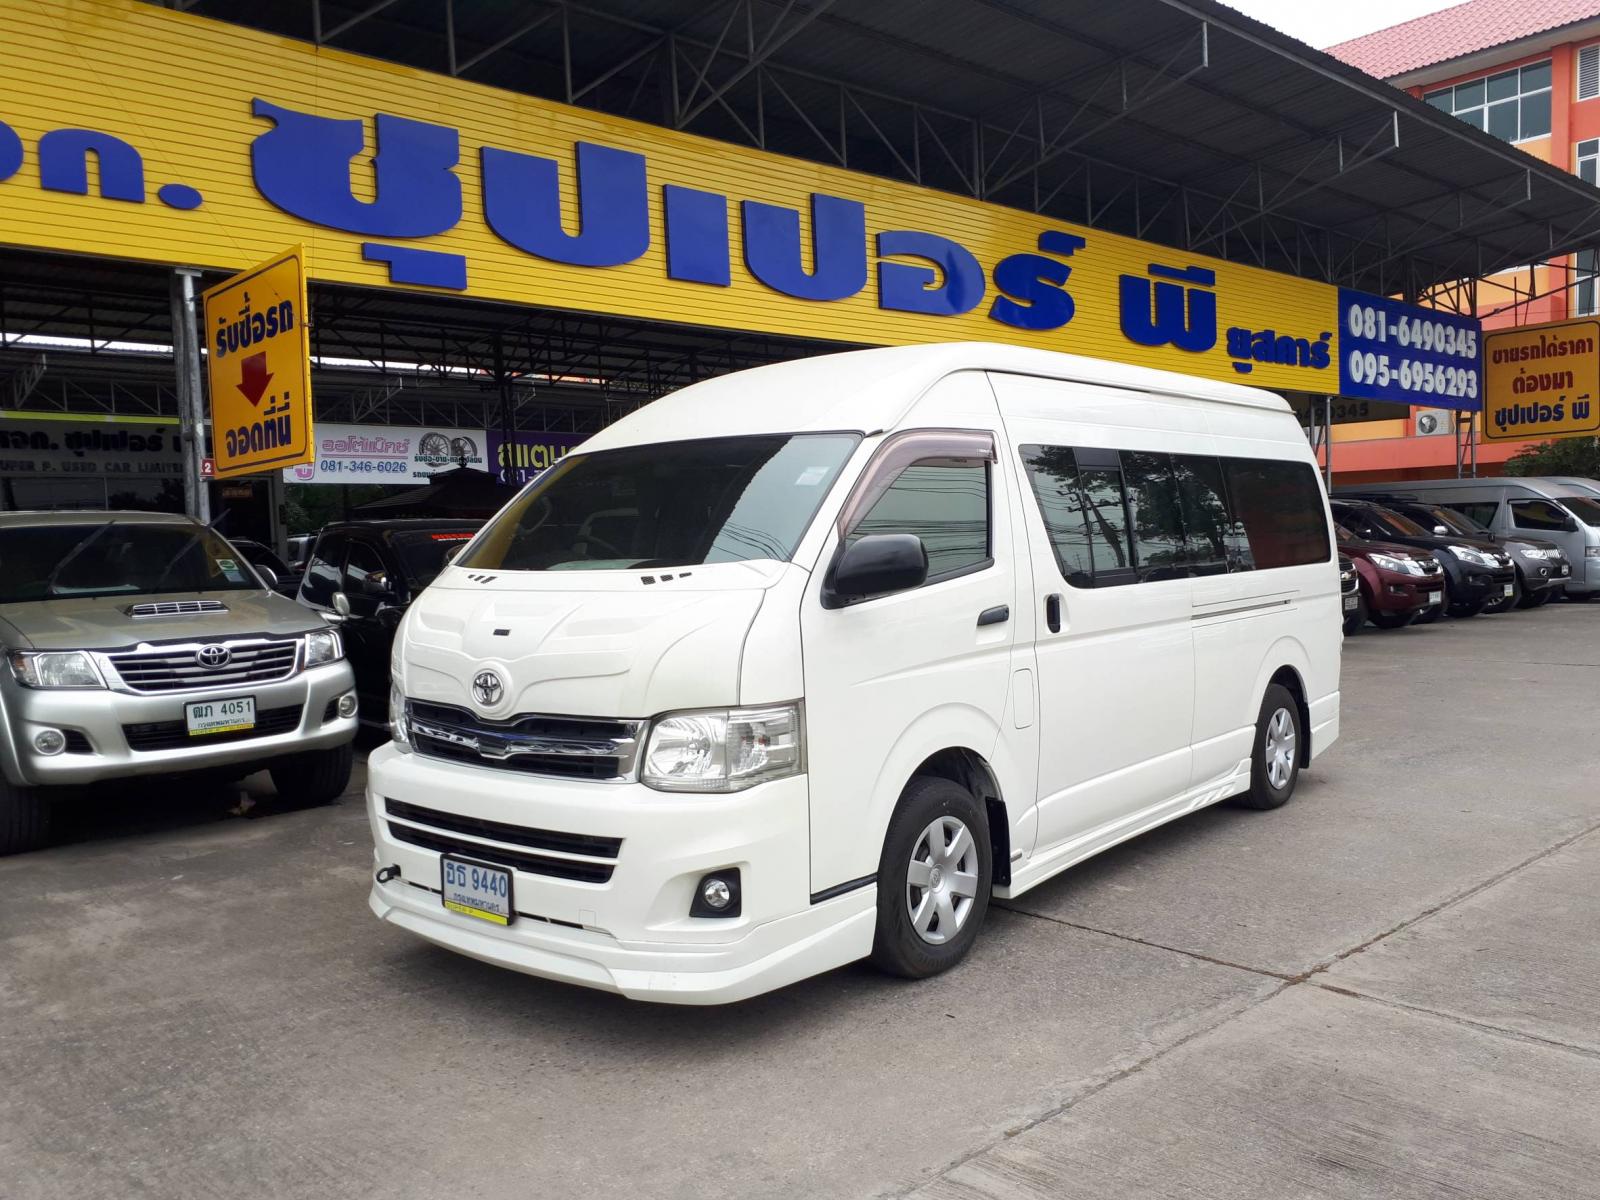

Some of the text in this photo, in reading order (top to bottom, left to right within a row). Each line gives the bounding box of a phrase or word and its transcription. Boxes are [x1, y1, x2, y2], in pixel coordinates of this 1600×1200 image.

[1119, 263, 1216, 352] พี
[216, 292, 294, 358] รับซื้อรถ
[1349, 304, 1476, 359] 081-6490345
[1492, 335, 1594, 364] ขายรถได้ราคา
[1350, 350, 1478, 399] 095-6956293
[1512, 368, 1574, 394] ต้องมา
[1572, 394, 1590, 419] พี
[226, 392, 291, 458] จอดที่นี่
[320, 460, 408, 472] 081-346-6026
[221, 701, 251, 715] 4051
[472, 868, 507, 898] 9440
